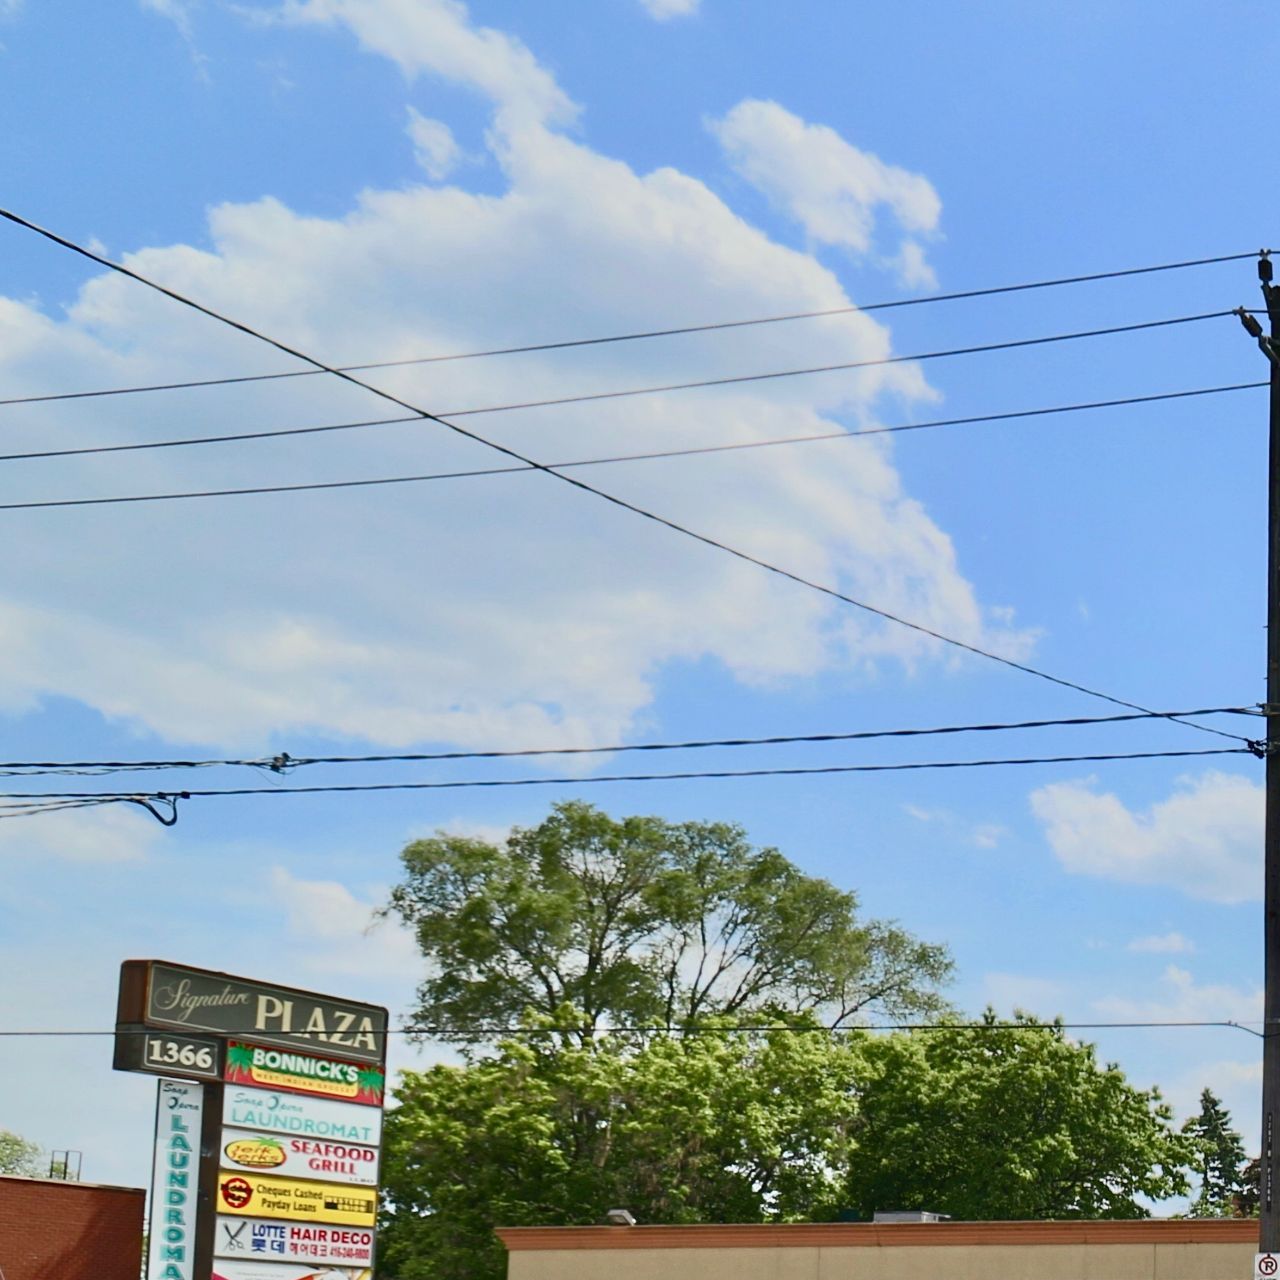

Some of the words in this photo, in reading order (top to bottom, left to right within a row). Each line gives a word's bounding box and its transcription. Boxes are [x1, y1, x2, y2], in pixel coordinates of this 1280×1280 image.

[255, 994, 377, 1051] PLAZA
[149, 1040, 212, 1068] 1366
[253, 1049, 359, 1082] BONNICK'S
[231, 1109, 371, 1141] LAUNDROMAT
[291, 1139, 375, 1162] SEAFOOD
[308, 1157, 357, 1175] GRILL
[257, 1184, 291, 1198] Cheques
[294, 1188, 323, 1200] Cashed
[262, 1198, 290, 1212] Payday
[293, 1202, 317, 1213] Loans
[252, 1223, 286, 1239] LOTTE
[291, 1227, 327, 1241] HAIR
[331, 1231, 371, 1245] DECO
